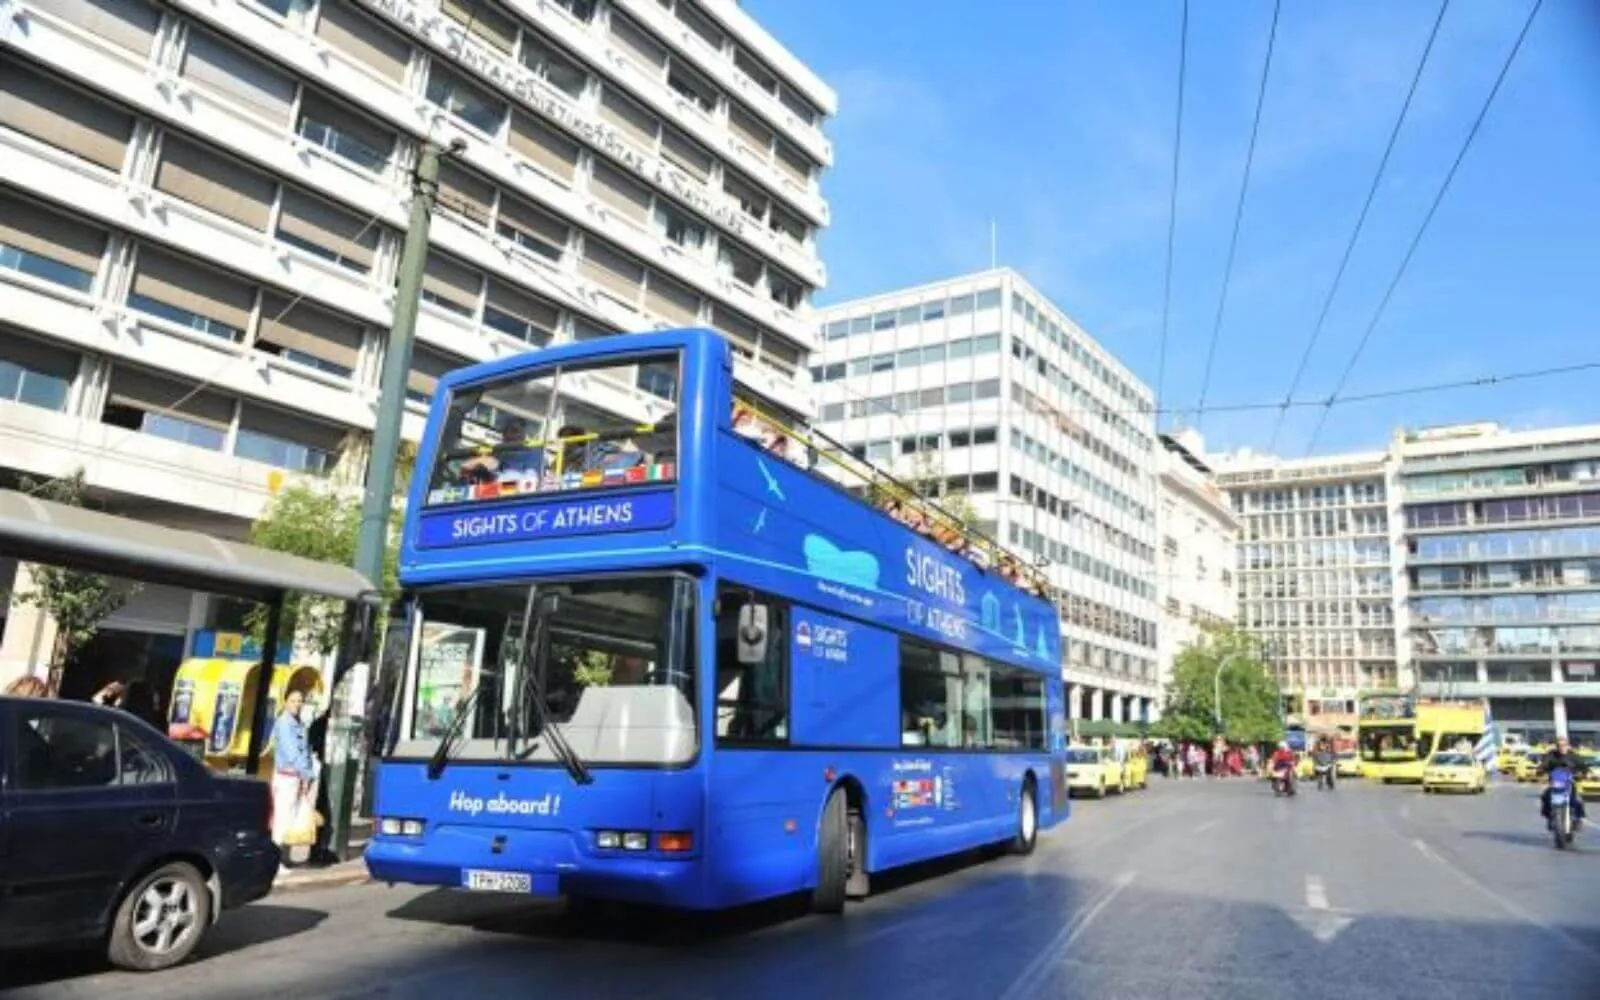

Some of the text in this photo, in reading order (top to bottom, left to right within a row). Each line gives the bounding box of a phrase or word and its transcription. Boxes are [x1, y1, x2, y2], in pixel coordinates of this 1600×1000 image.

[452, 502, 632, 537] SIGHTS OF ATHENS
[906, 547, 965, 607] SIGHTS
[450, 791, 484, 816] Hop
